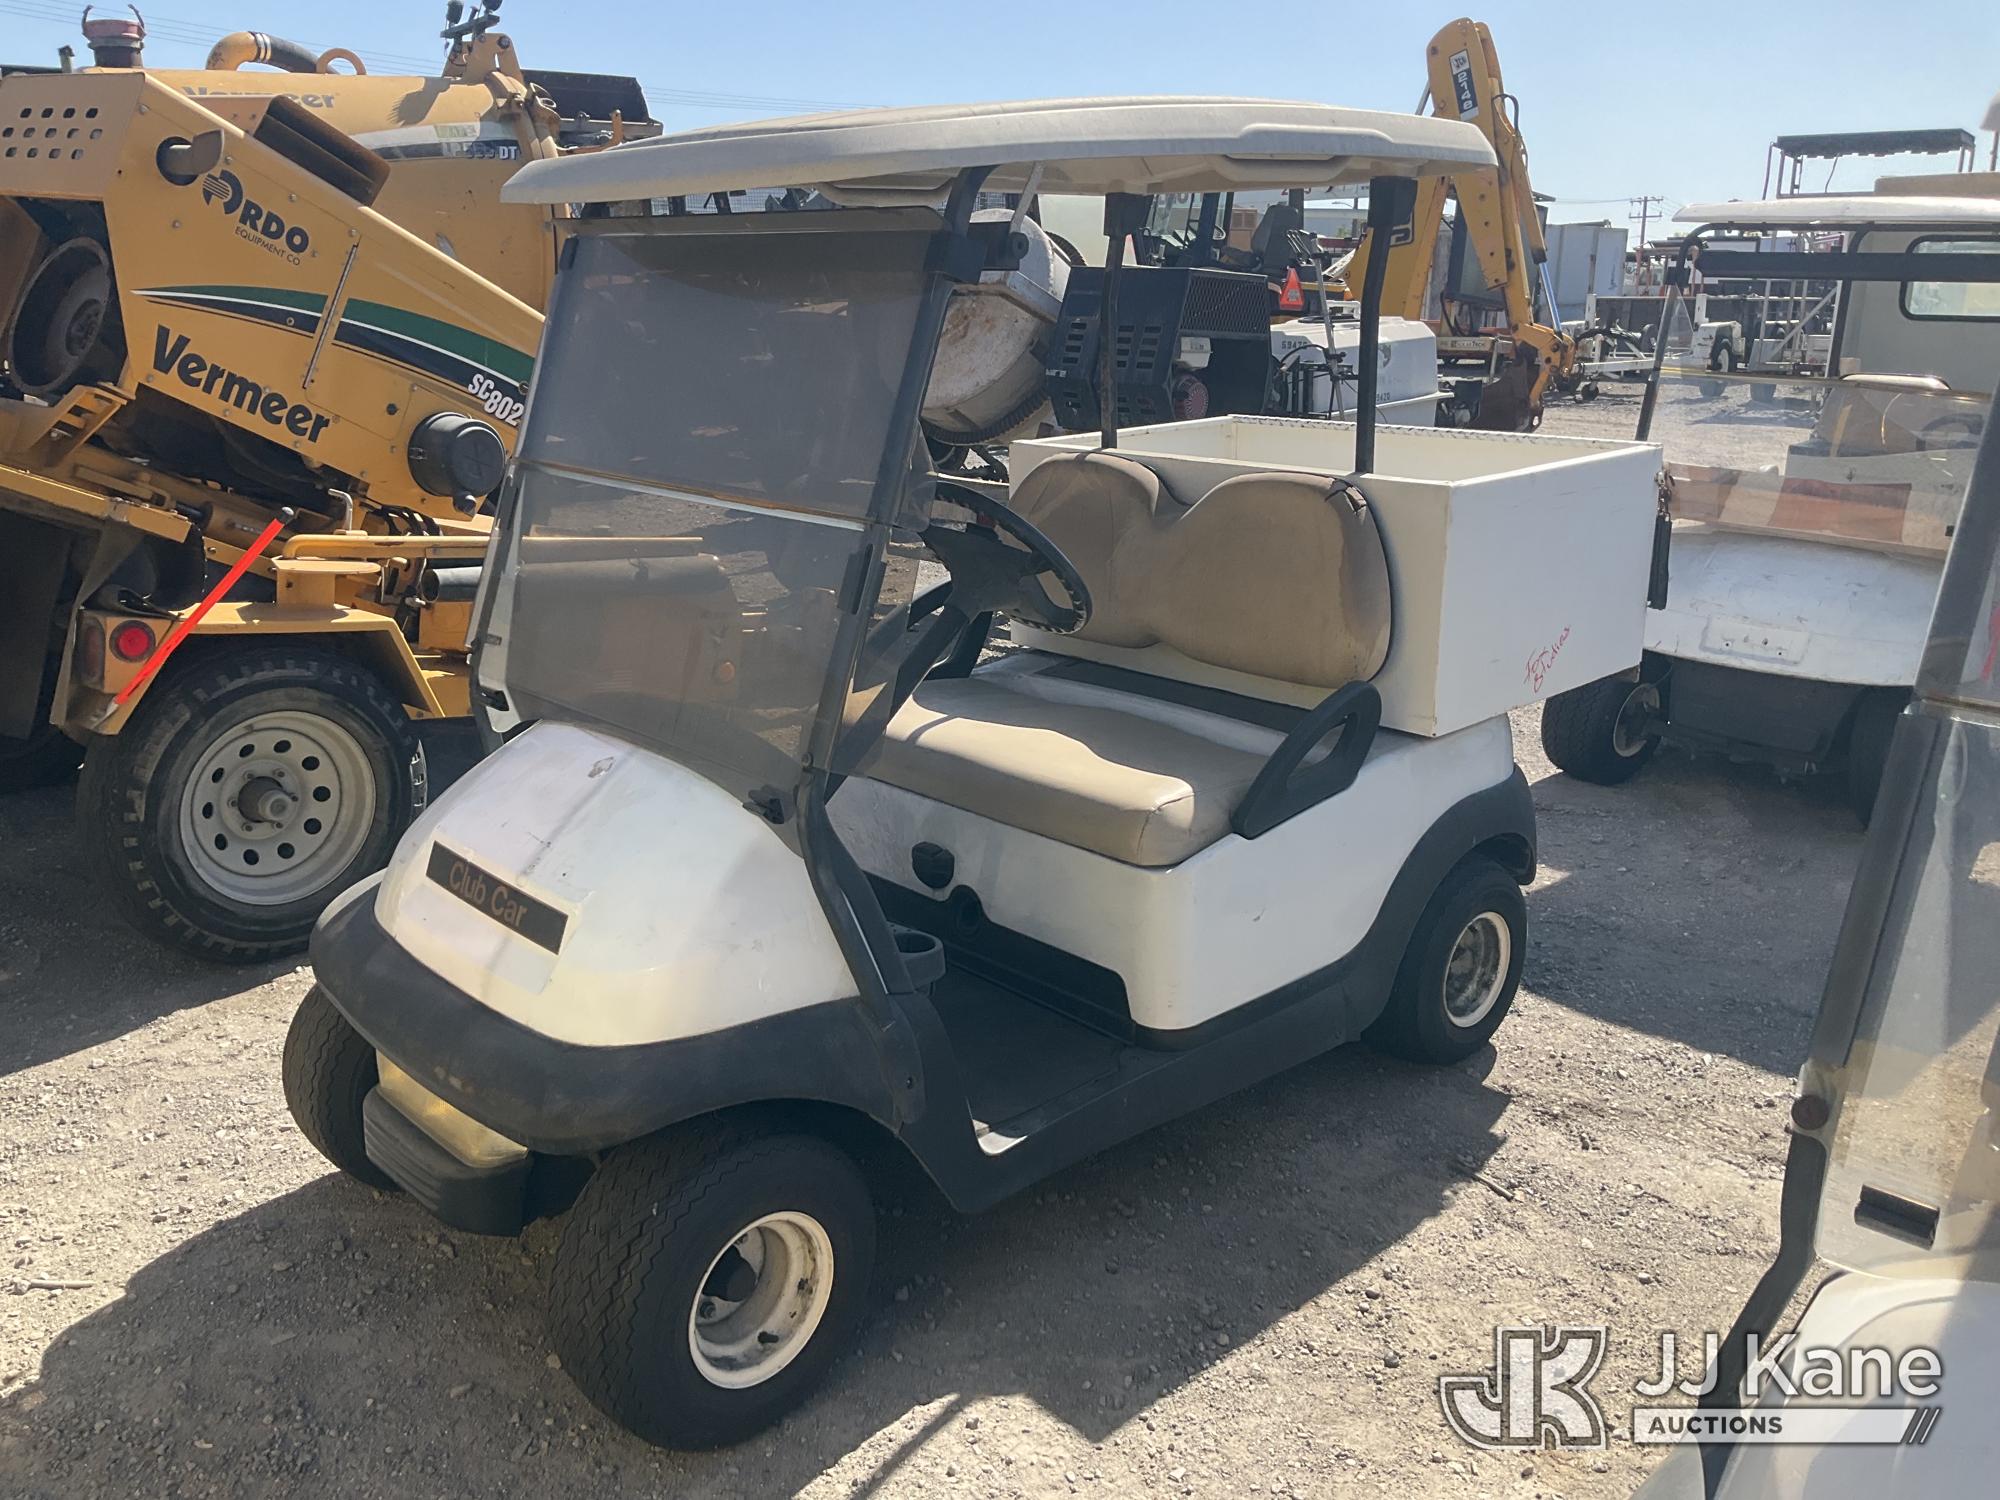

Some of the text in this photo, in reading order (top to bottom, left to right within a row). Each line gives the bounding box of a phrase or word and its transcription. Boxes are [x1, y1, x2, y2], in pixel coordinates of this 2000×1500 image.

[235, 226, 301, 266] EQUIPMENT CO
[153, 324, 330, 443] Vermeer
[468, 373, 525, 427] SC802
[450, 861, 528, 927] Club Car
